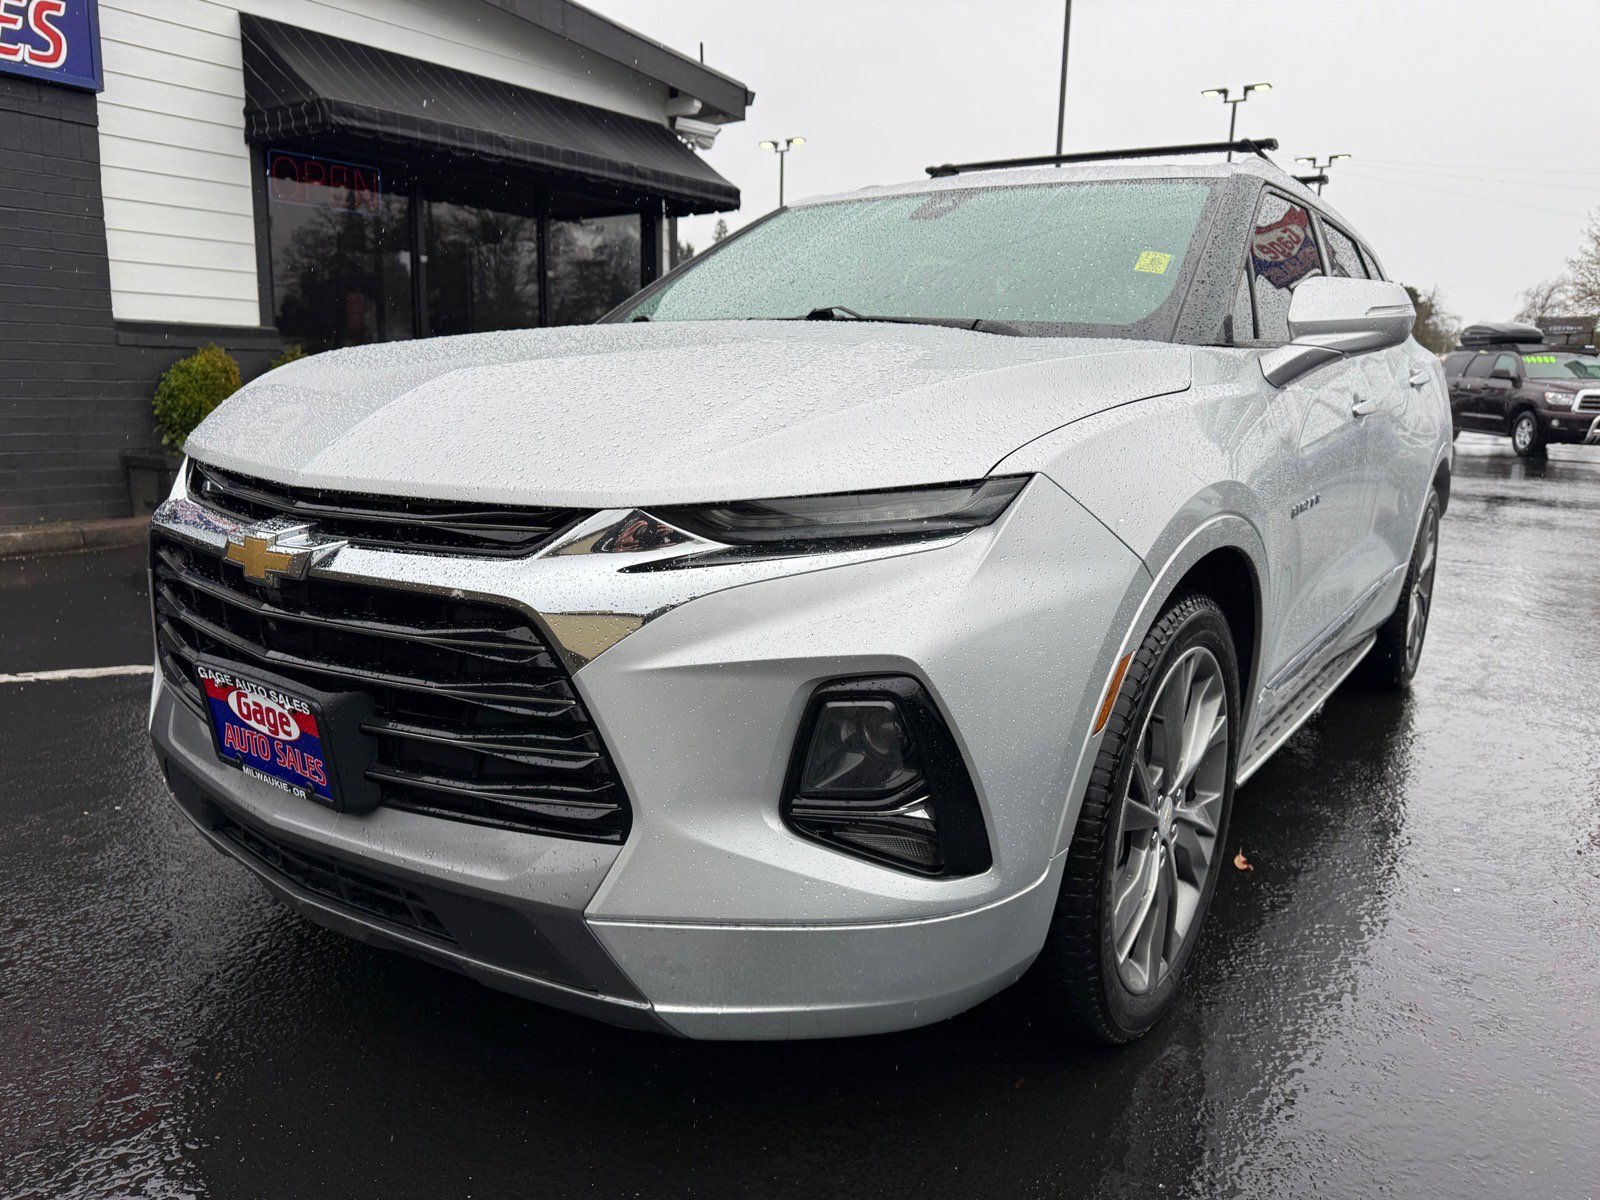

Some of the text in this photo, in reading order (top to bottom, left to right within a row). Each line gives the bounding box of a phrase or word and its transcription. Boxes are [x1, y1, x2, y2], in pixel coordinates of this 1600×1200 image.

[272, 156, 378, 210] OPEN
[197, 666, 310, 715] GAGE AUTO SALES
[235, 691, 292, 737] Gage
[225, 722, 326, 787] AUTO SALES
[292, 786, 307, 800] OR
